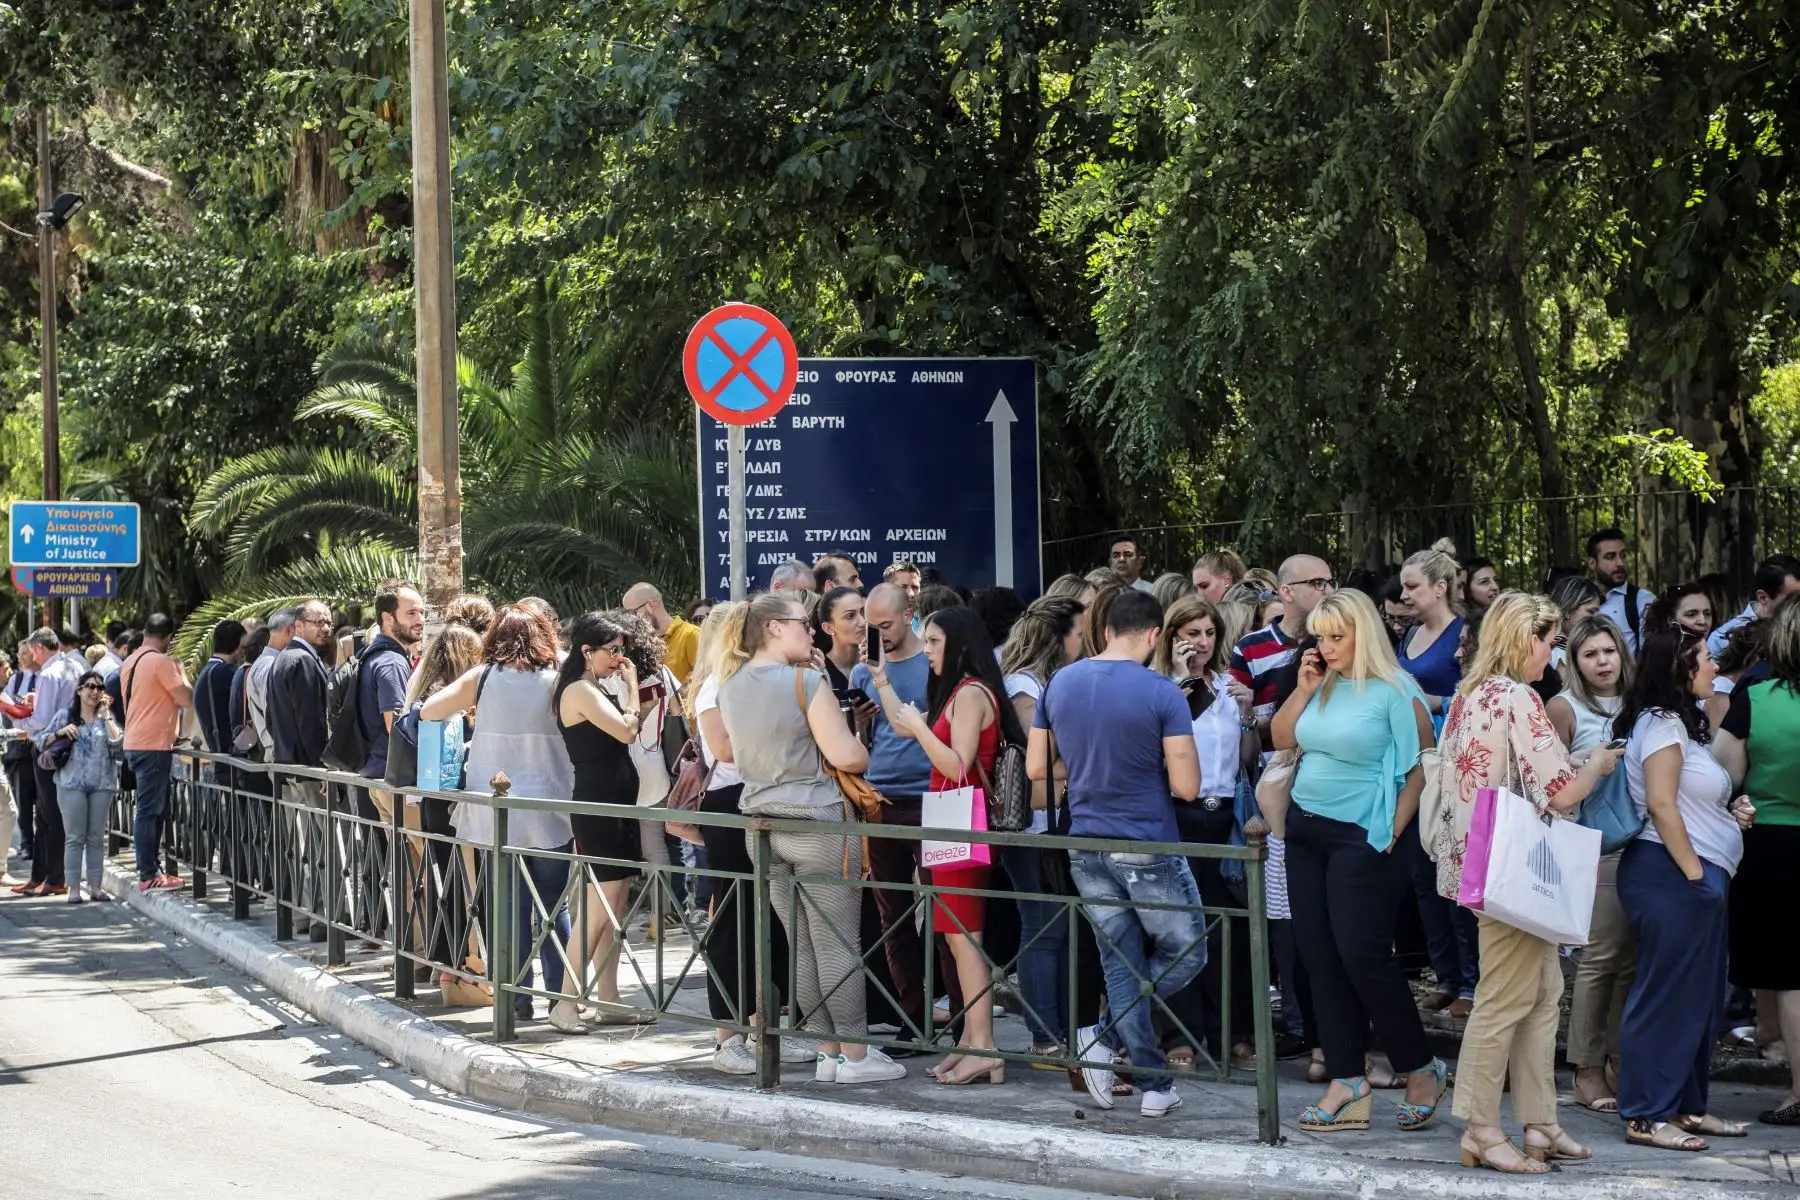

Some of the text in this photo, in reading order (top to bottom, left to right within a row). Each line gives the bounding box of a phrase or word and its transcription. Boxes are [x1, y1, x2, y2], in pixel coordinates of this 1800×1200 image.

[835, 371, 896, 383] ΦΡΟΥΡΑΣ
[911, 371, 964, 383] ΑΘΗΝΩΝ
[792, 416, 845, 429] ΒΑΡΥΤΗ
[46, 508, 114, 521] Υπουργείο
[46, 521, 127, 534] Δικαιοσύνης
[45, 534, 98, 547] Ministry
[886, 529, 947, 541] ΑΡΧΕΙΩΝ
[45, 547, 107, 560] of Justice
[893, 551, 936, 563] ΕΡΓΩΝ
[36, 572, 101, 582] ΦΡΟΥΡΑΡΧΕΙΟ
[49, 585, 89, 595] ΑΘΗΝΩΝ
[924, 846, 967, 863] breeze
